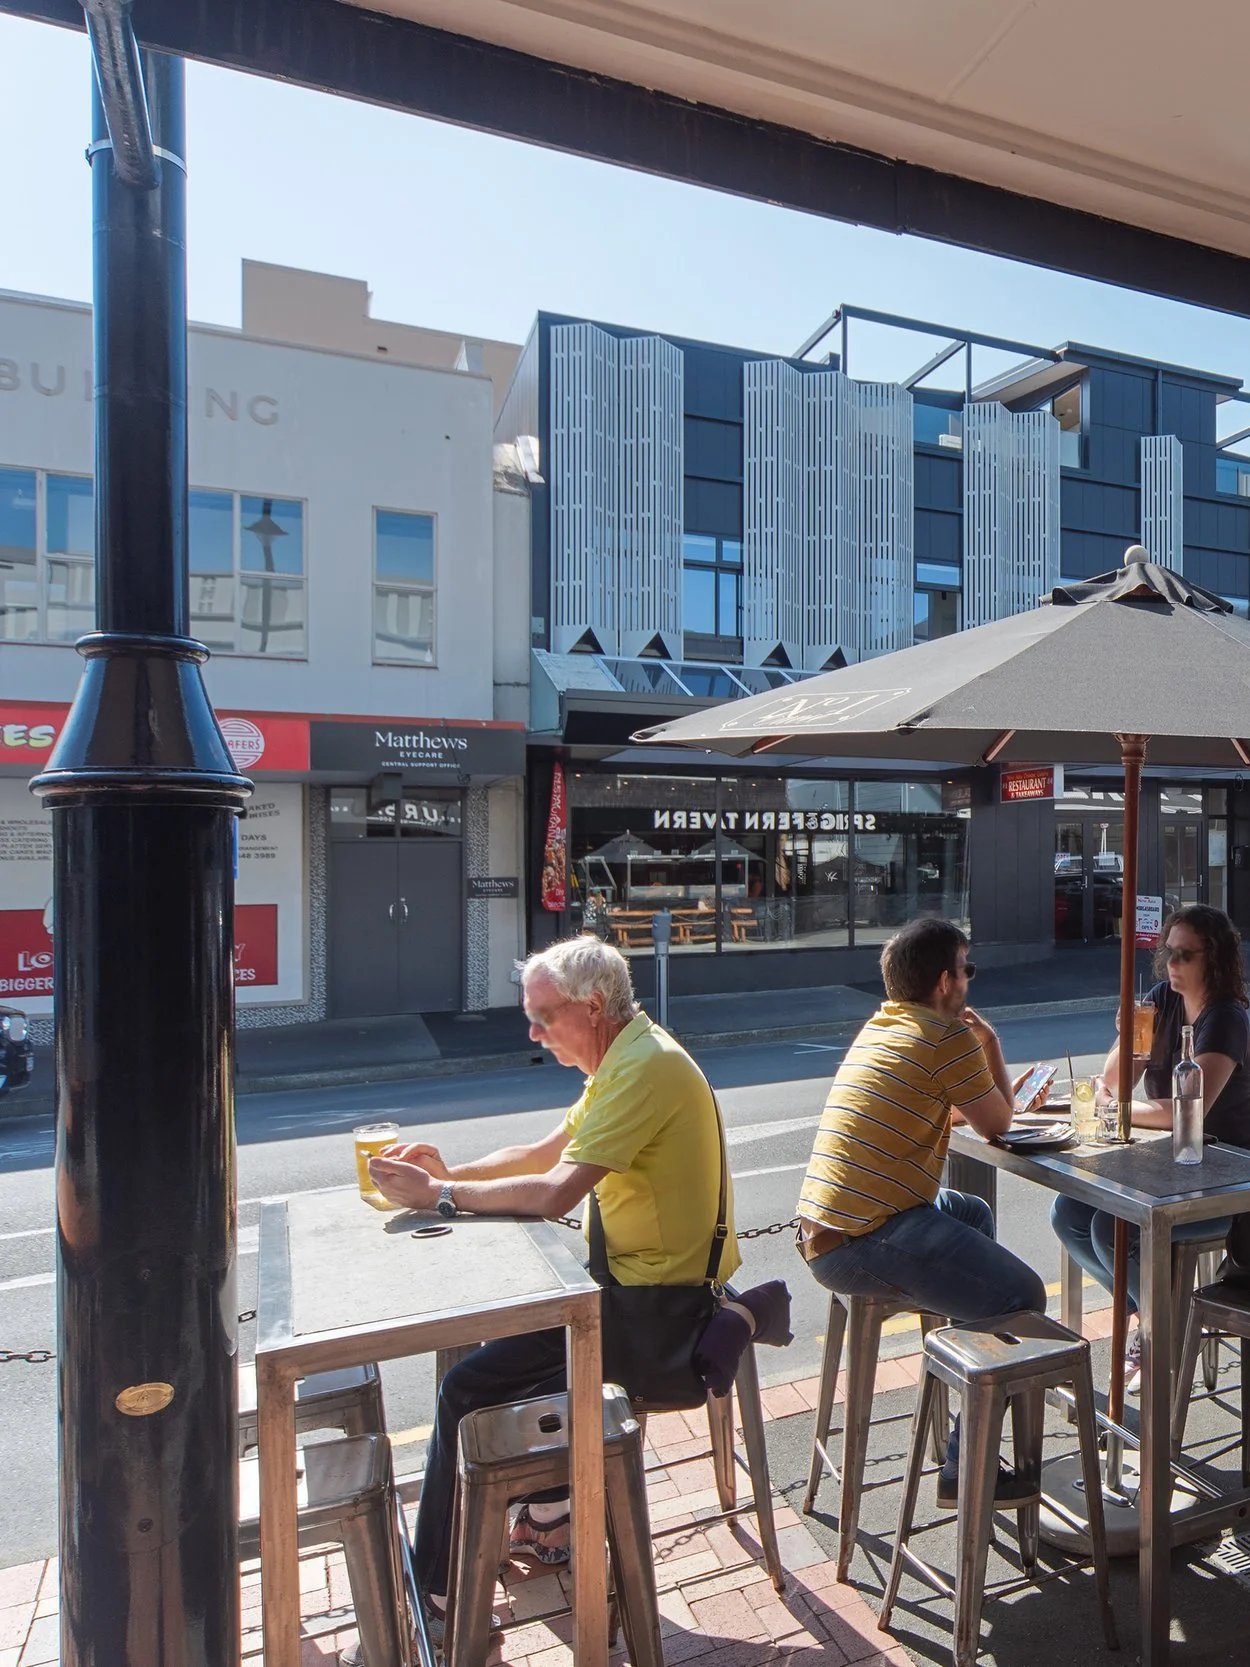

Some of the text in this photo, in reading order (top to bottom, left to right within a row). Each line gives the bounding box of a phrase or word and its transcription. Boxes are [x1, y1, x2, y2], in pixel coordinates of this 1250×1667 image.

[0, 357, 280, 426] BUING
[0, 722, 56, 749] ES
[375, 731, 468, 750] Matthews
[227, 739, 261, 750] AFERS
[399, 751, 444, 759] EYECARE
[1008, 777, 1047, 792] RESTAURANT
[1015, 789, 1045, 799] TAKEAWAYS
[241, 834, 268, 842] DAYS
[472, 879, 515, 889] Matthews
[234, 967, 257, 982] CES
[0, 976, 54, 992] BIGGER
